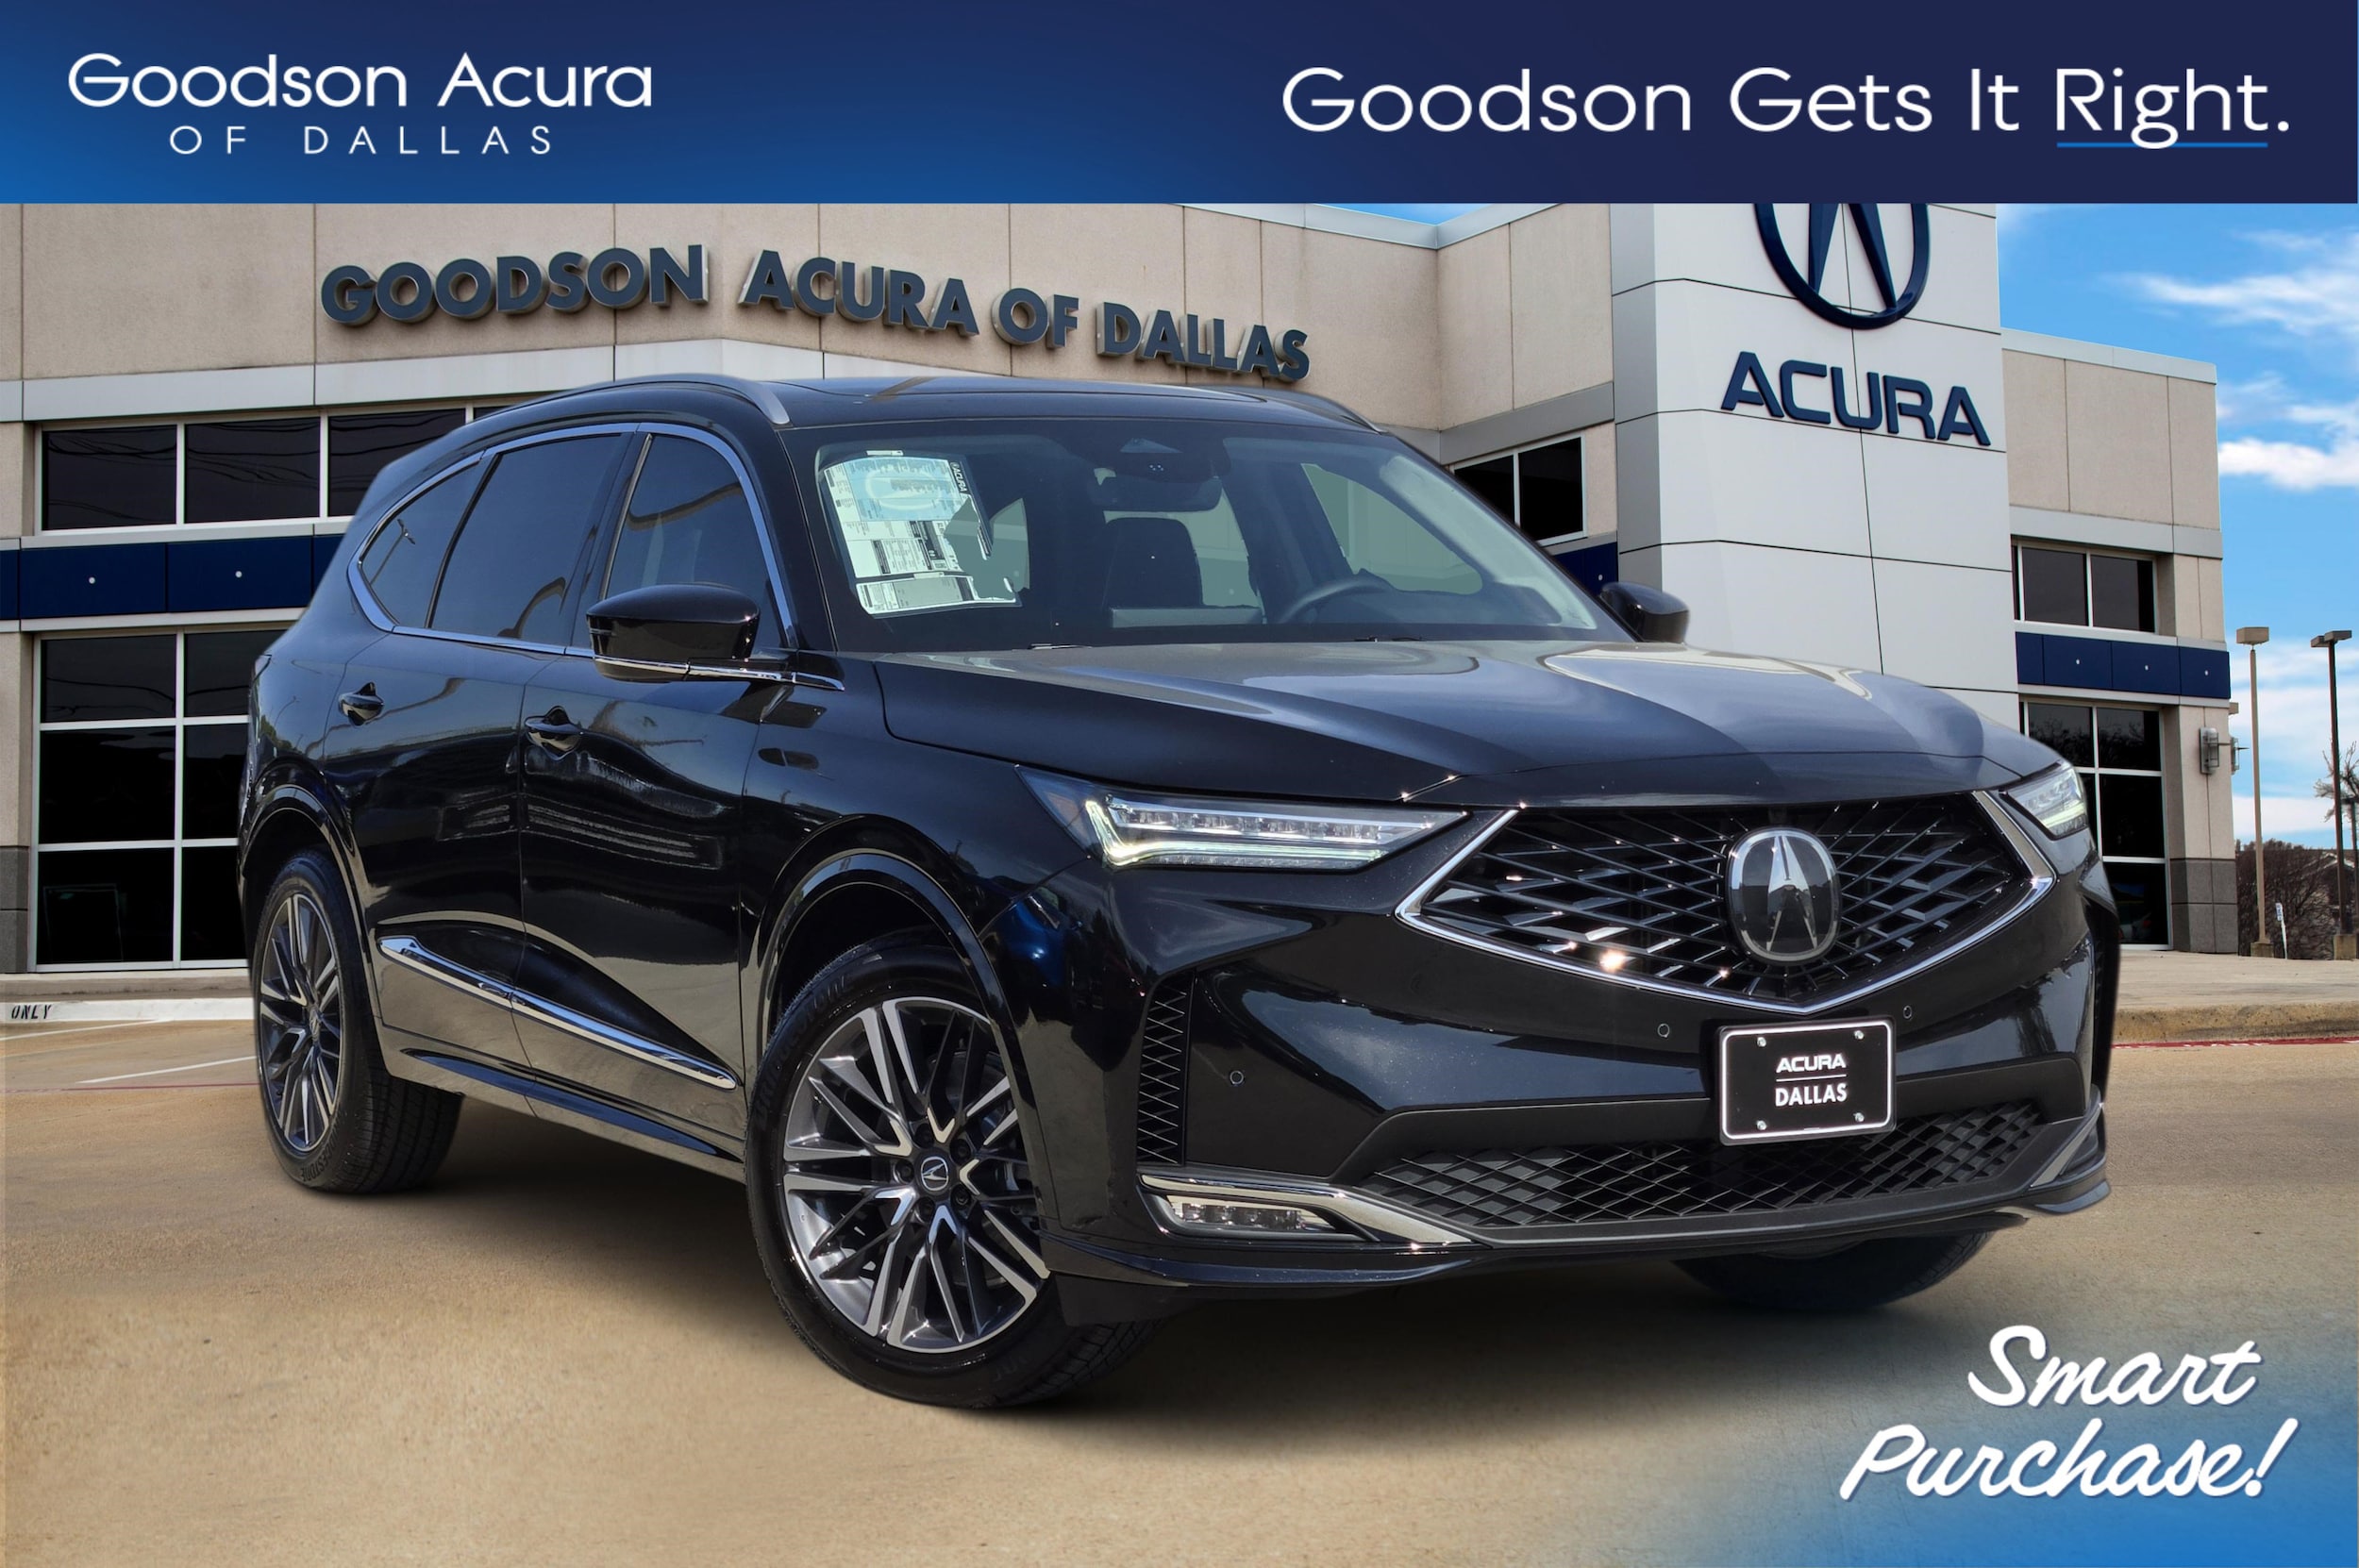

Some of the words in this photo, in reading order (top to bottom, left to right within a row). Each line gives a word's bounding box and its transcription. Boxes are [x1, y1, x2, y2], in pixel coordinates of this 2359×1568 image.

[321, 243, 709, 326] GOODSON
[739, 249, 979, 337] ACURA
[993, 287, 1079, 349] OF
[1096, 301, 1310, 382] DALLAS
[1720, 351, 1991, 446] ACURA
[953, 467, 967, 492] ACURA
[11, 1004, 52, 1020] ONLY
[1776, 1053, 1847, 1074] ACURA
[1775, 1083, 1848, 1107] DALLAS
